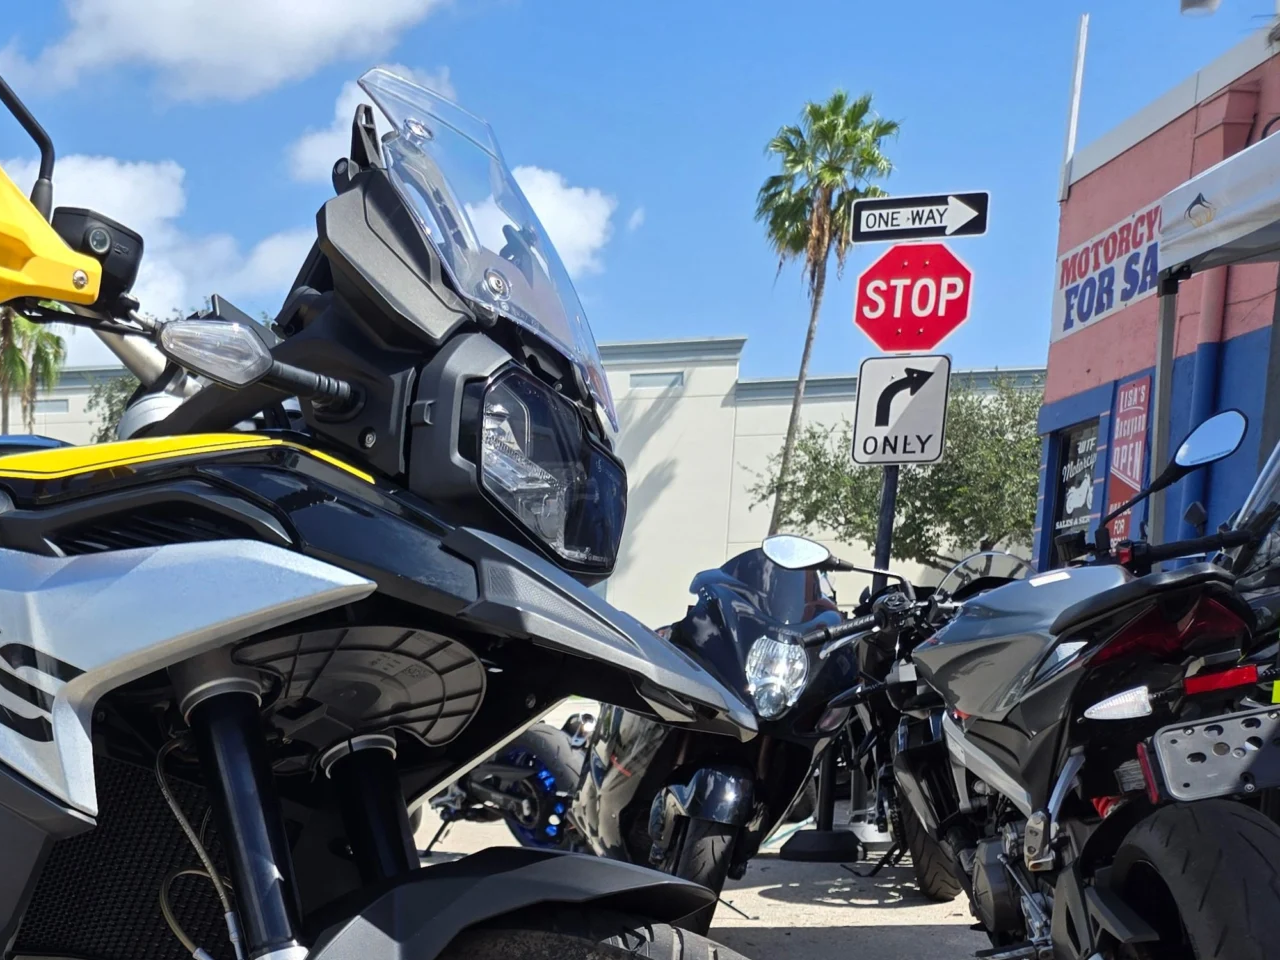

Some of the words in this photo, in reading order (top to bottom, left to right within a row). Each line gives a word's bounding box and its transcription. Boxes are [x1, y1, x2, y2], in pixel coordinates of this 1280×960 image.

[865, 211, 901, 229] ONE
[911, 207, 948, 226] WAY
[1059, 204, 1163, 290] MOTORCY
[862, 276, 965, 319] STOP
[1062, 266, 1116, 332] FOR
[862, 433, 934, 456] ONLY
[1113, 440, 1143, 481] OPEN
[1055, 517, 1073, 530] SALES
